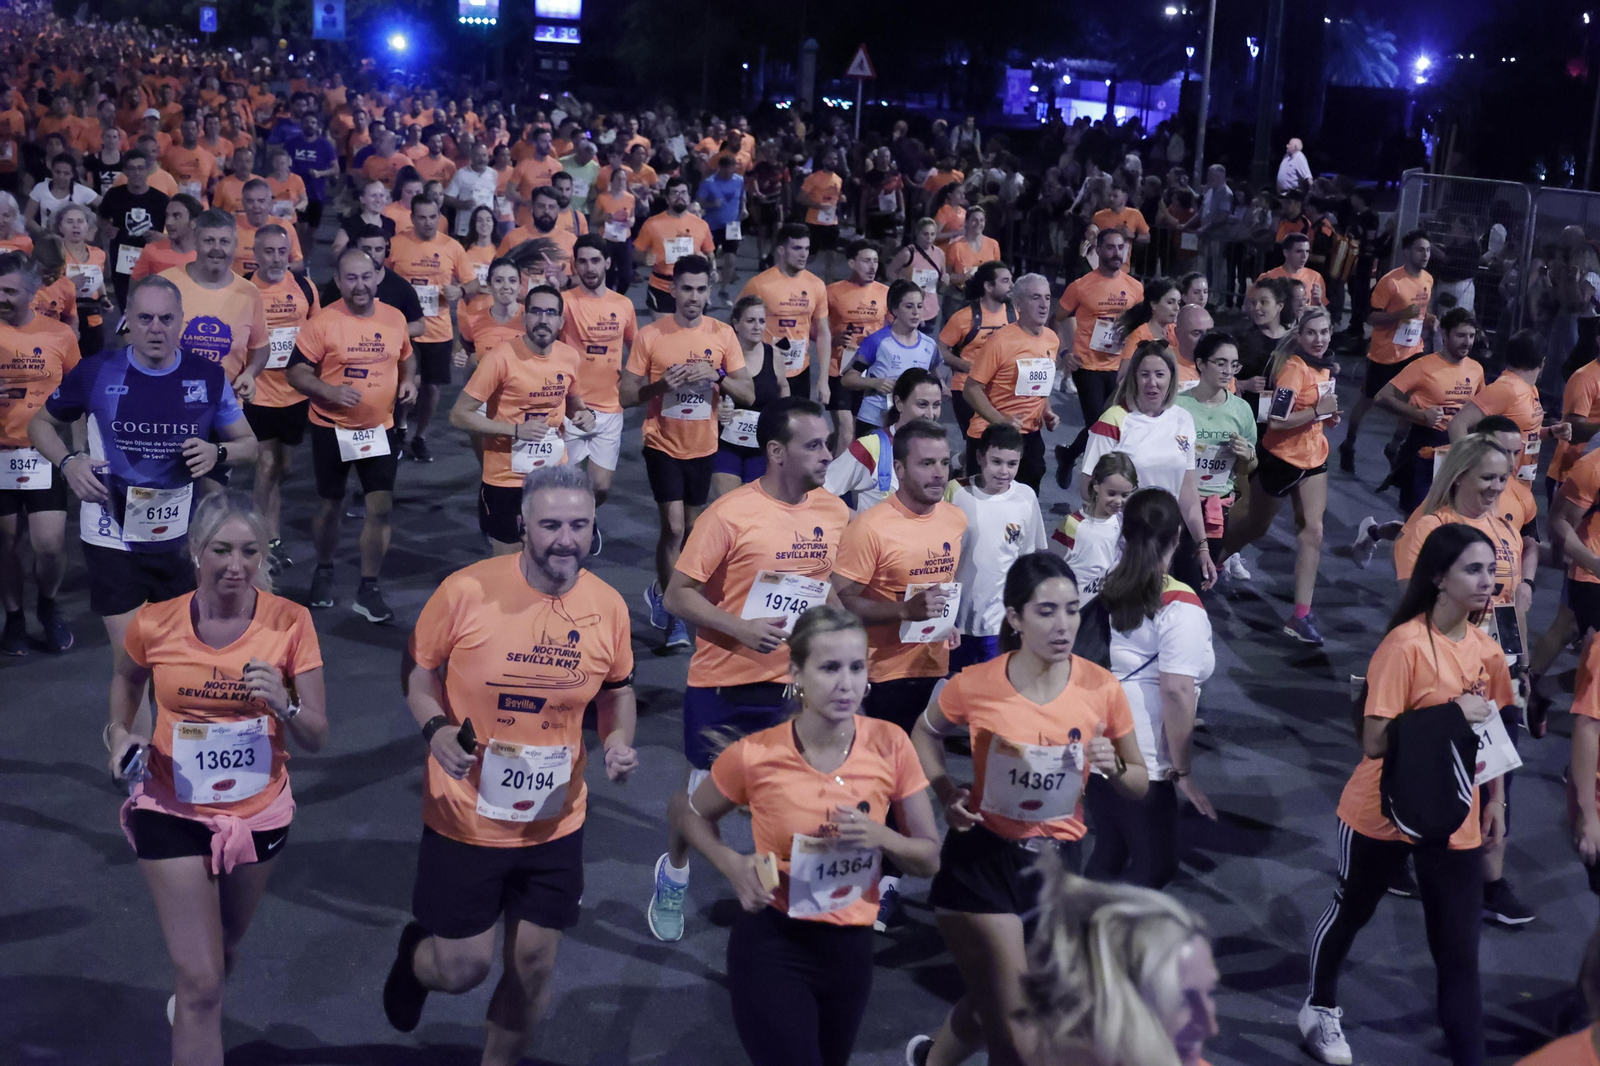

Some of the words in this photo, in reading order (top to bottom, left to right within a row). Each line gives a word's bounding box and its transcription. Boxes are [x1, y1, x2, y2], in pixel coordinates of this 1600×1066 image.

[203, 10, 213, 20] P
[194, 335, 231, 344] NOCTURNA
[271, 340, 292, 352] 3368
[1029, 371, 1048, 381] 8803
[676, 393, 705, 404] 10226
[111, 420, 200, 436] COGITISE
[352, 430, 375, 442] 4847
[528, 442, 553, 454] 7743
[10, 459, 38, 470] 8347
[1196, 458, 1226, 470] 13505
[146, 506, 179, 520] 6134
[775, 550, 809, 560] SEVILLA
[924, 557, 954, 566] NOCTURNA
[909, 567, 938, 576] SEVILLA
[765, 592, 808, 615] 19748
[532, 645, 582, 659] NOCTURNA
[506, 652, 554, 666] SEVILLA
[177, 687, 228, 700] SEVILLA
[505, 697, 535, 708] Sevilla
[196, 748, 256, 770] 13623
[501, 768, 554, 790] 20194
[1009, 768, 1066, 791] 14367
[816, 855, 873, 880] 14364
